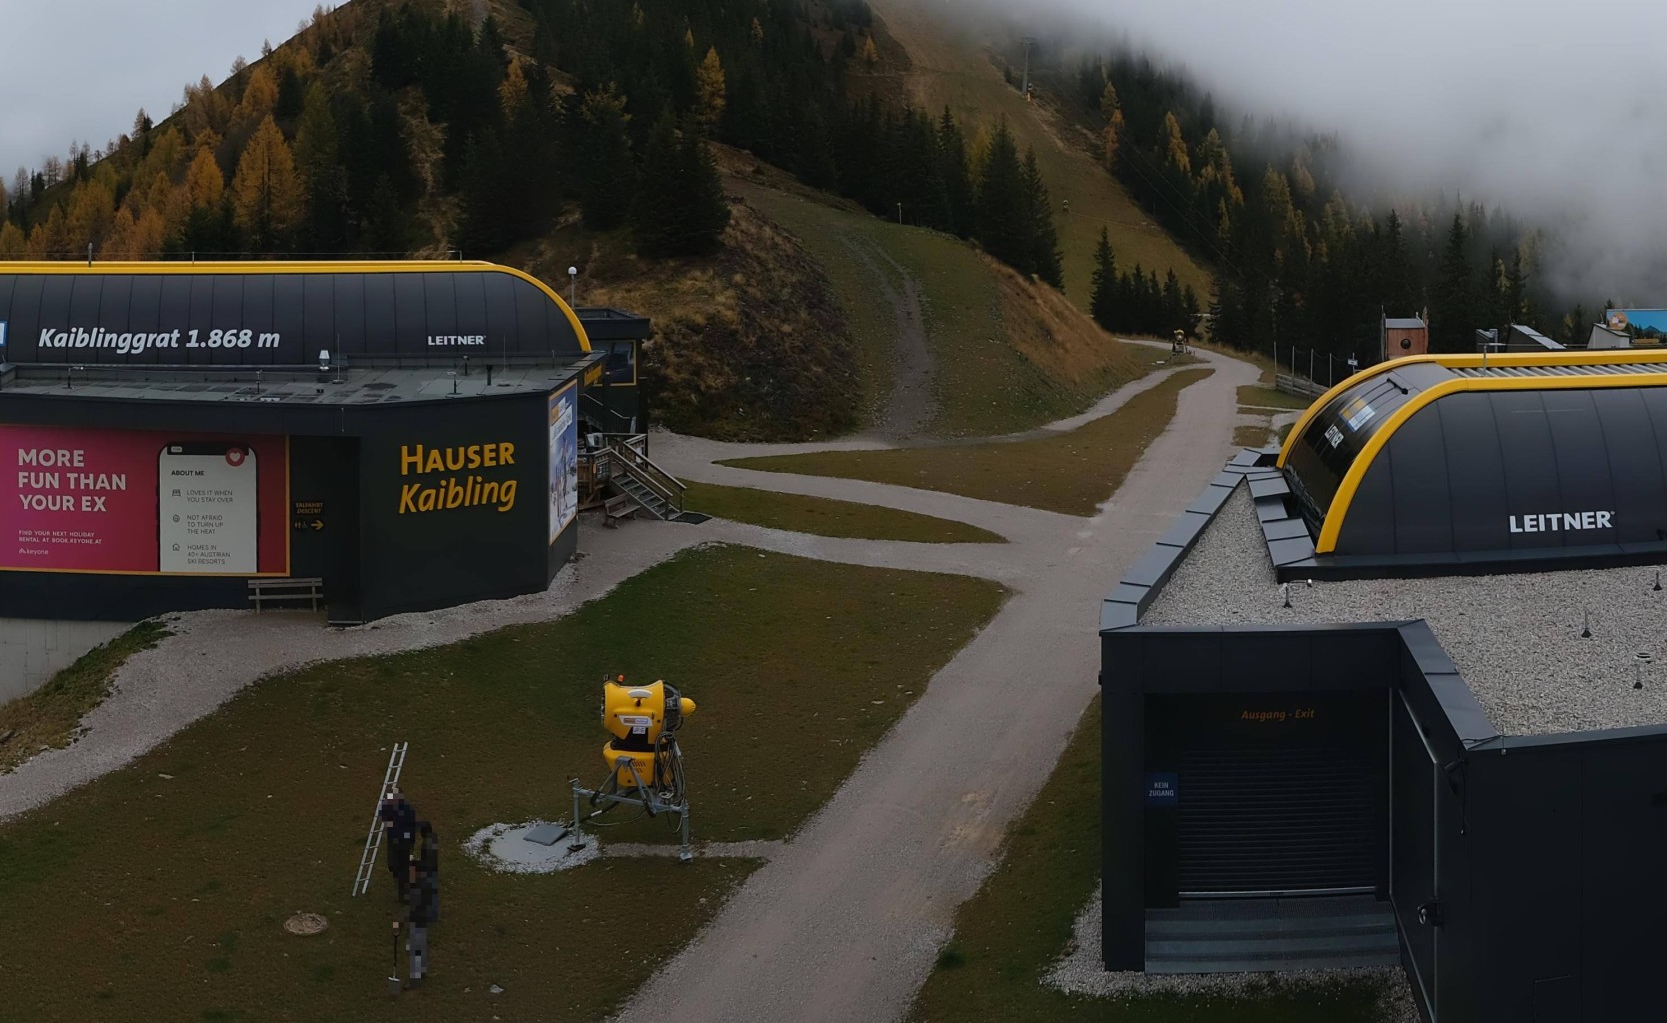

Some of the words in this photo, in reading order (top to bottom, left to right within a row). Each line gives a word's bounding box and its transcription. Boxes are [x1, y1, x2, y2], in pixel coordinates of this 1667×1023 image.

[38, 327, 180, 354] Kaiblinggrat
[185, 329, 252, 348] 1.868
[258, 333, 280, 348] m
[18, 448, 85, 467] MORE
[401, 442, 515, 475] HAUSER
[18, 472, 59, 489] FUN
[67, 473, 126, 490] THAN
[19, 494, 75, 511] YOUR
[81, 496, 106, 512] EX
[399, 476, 518, 514] Kaibling
[1509, 511, 1613, 533] LEITNER
[1241, 710, 1286, 722] Ausgang
[1295, 709, 1315, 718] Exit
